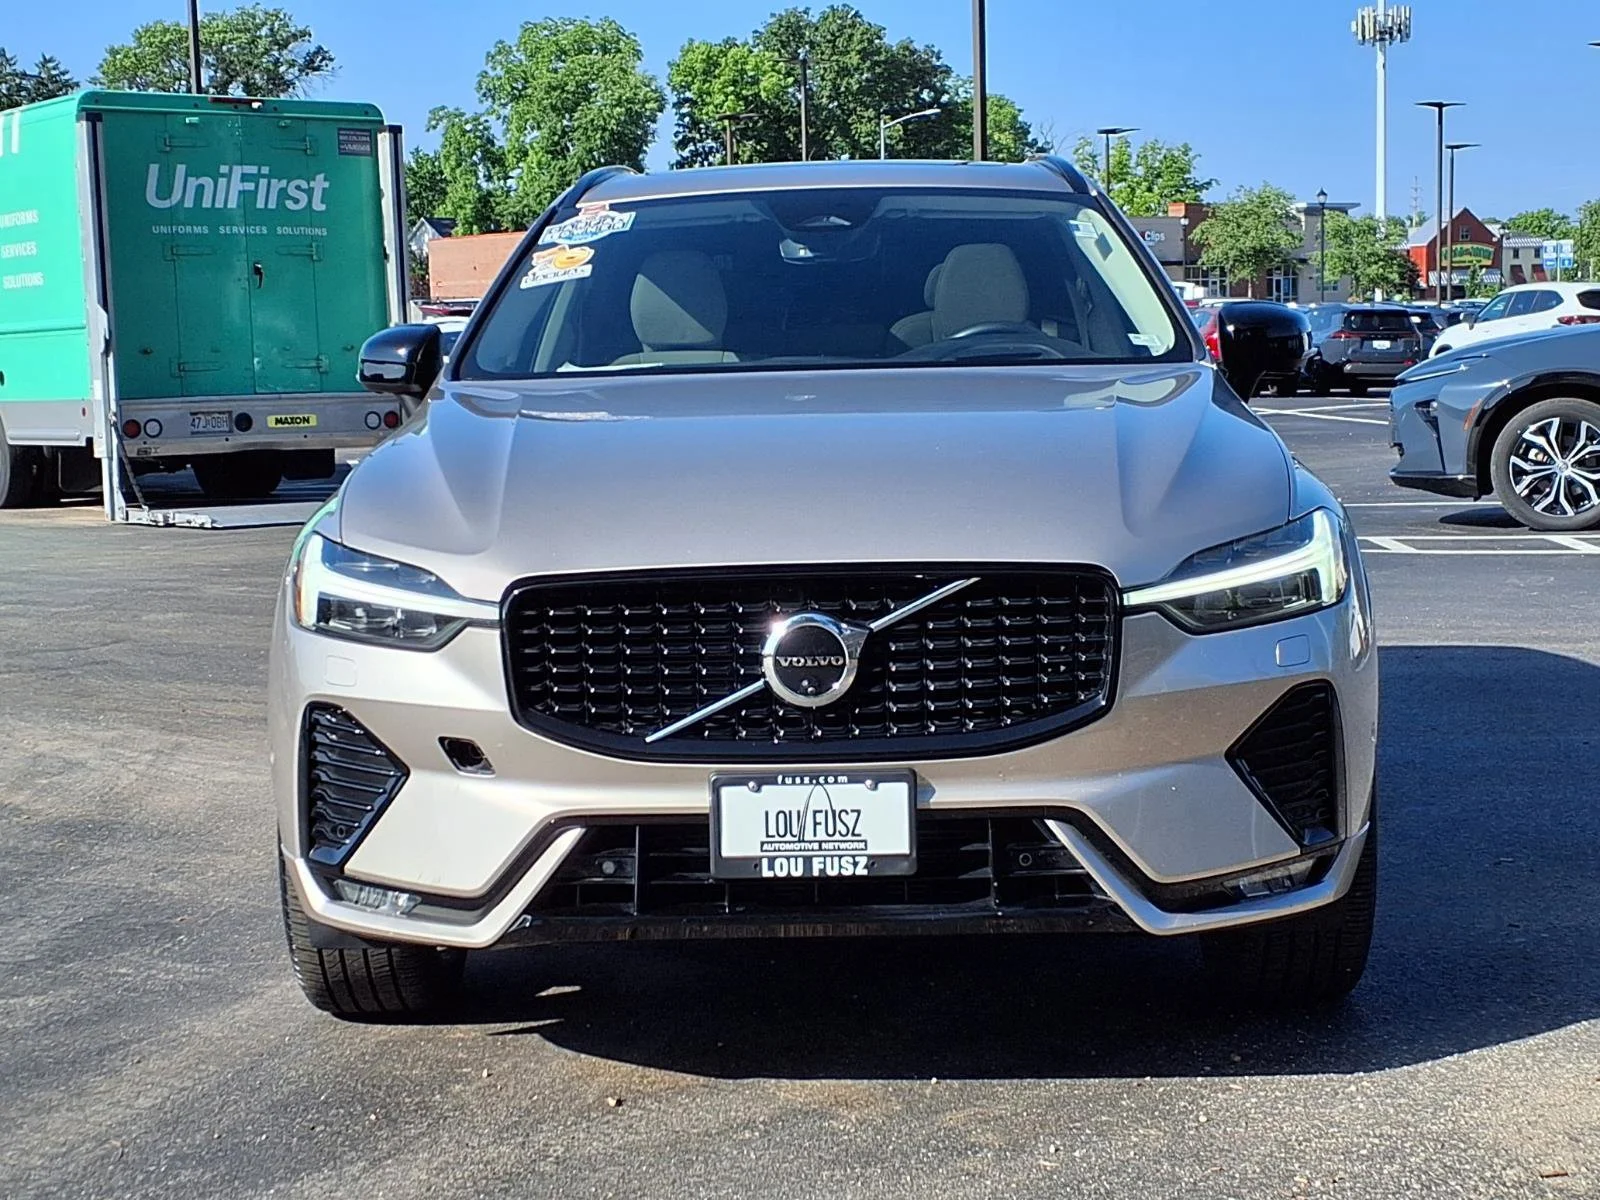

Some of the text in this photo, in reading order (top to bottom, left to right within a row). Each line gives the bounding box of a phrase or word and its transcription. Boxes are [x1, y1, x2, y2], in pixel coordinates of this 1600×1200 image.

[146, 163, 330, 211] UniFirst
[152, 225, 328, 236] UNIFORMS SERVICES SOLUTIONS
[1, 240, 37, 259] SERVICES
[3, 271, 44, 289] SOLUTIONS
[274, 415, 310, 426] MAXON
[776, 655, 844, 667] VOLVO
[777, 774, 849, 785] fusz.com
[764, 808, 862, 839] LOU FUSZ
[762, 841, 866, 852] AUTOMOTIVE NETWORK
[761, 856, 869, 878] LOU FUSZ
